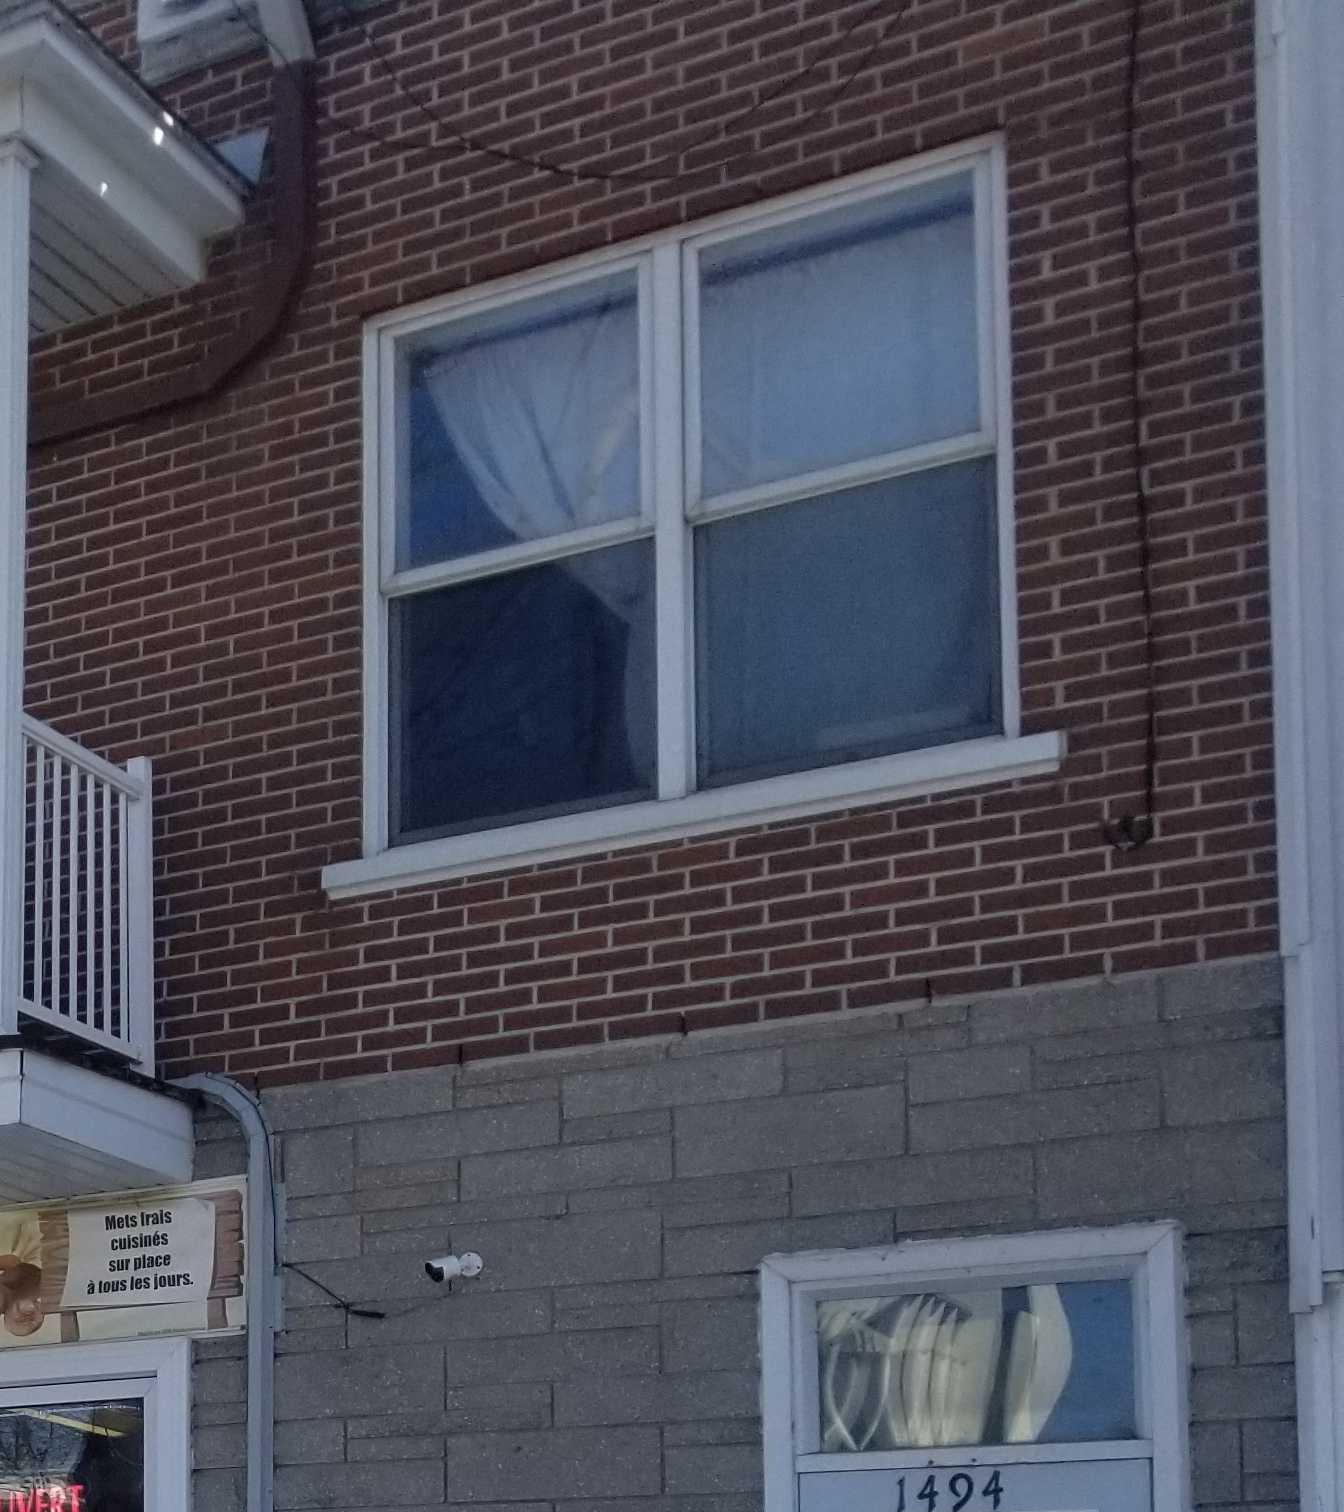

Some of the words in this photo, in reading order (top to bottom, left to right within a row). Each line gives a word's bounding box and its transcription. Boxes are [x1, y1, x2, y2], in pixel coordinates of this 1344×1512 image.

[104, 1214, 138, 1231] Mets
[140, 1209, 173, 1226] frais
[110, 1231, 169, 1251] cuisinés
[108, 1259, 131, 1273] sur
[133, 1253, 172, 1272] place
[86, 1279, 95, 1295] à
[98, 1278, 128, 1294] tous
[129, 1276, 151, 1291] les
[153, 1272, 194, 1291] jours.
